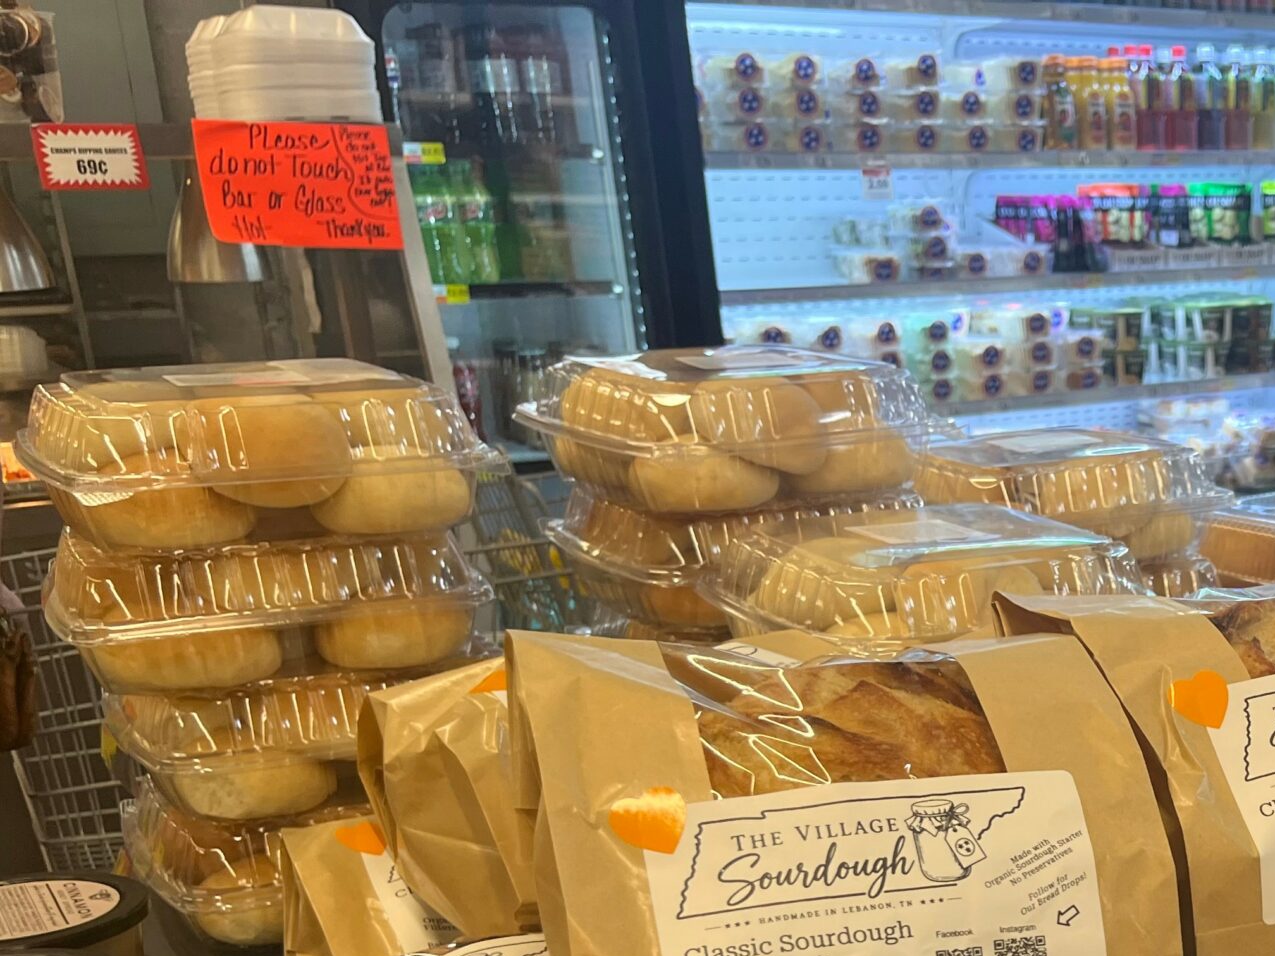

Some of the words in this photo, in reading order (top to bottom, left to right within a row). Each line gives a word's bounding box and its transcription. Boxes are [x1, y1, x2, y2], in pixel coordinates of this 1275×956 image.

[290, 153, 351, 178] Touch
[222, 181, 254, 209] Bar
[268, 192, 286, 210] or
[730, 831, 784, 851] THE
[795, 818, 900, 842] VILLAGE
[984, 868, 1015, 889] Organic
[1015, 843, 1057, 871] Sourdough
[1057, 829, 1083, 849] Starter
[1010, 849, 1033, 864] Made
[1034, 839, 1050, 852] with
[718, 836, 915, 906] Sourdough
[1009, 877, 1021, 886] No
[1022, 847, 1073, 879] Preservatives
[1028, 882, 1055, 901] Follow
[1055, 873, 1068, 889] for
[1020, 904, 1036, 915] Our
[1038, 889, 1060, 906] Bread
[759, 910, 820, 925] HANDMADE
[936, 929, 973, 938] Facebook
[1000, 924, 1036, 933] Instagram
[779, 921, 914, 953] Sourdough
